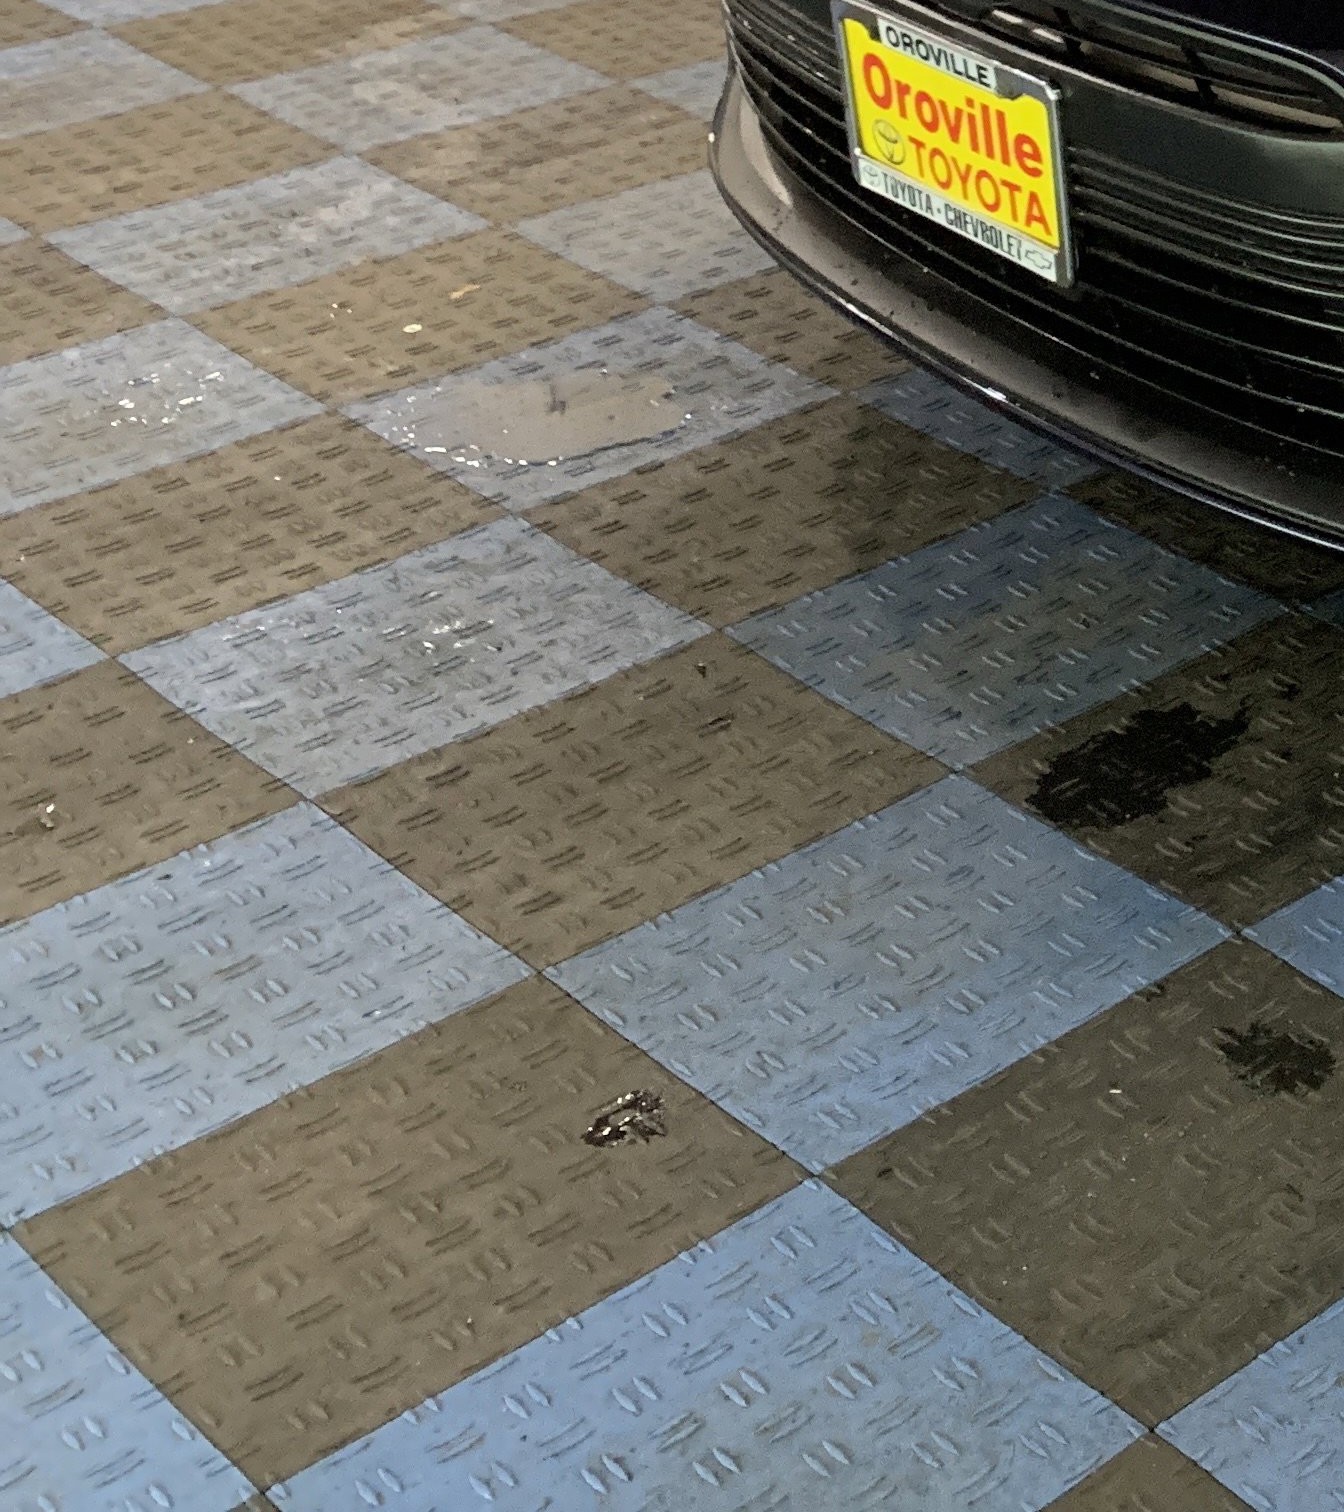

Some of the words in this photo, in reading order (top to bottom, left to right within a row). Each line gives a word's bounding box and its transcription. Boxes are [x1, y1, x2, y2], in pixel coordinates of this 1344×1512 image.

[885, 25, 991, 89] OROVILLE
[863, 52, 1044, 178] Oroville
[881, 171, 935, 215] TOYOTA
[944, 203, 1025, 262] CHEVROLET
[907, 135, 1053, 236] TOYOTA
